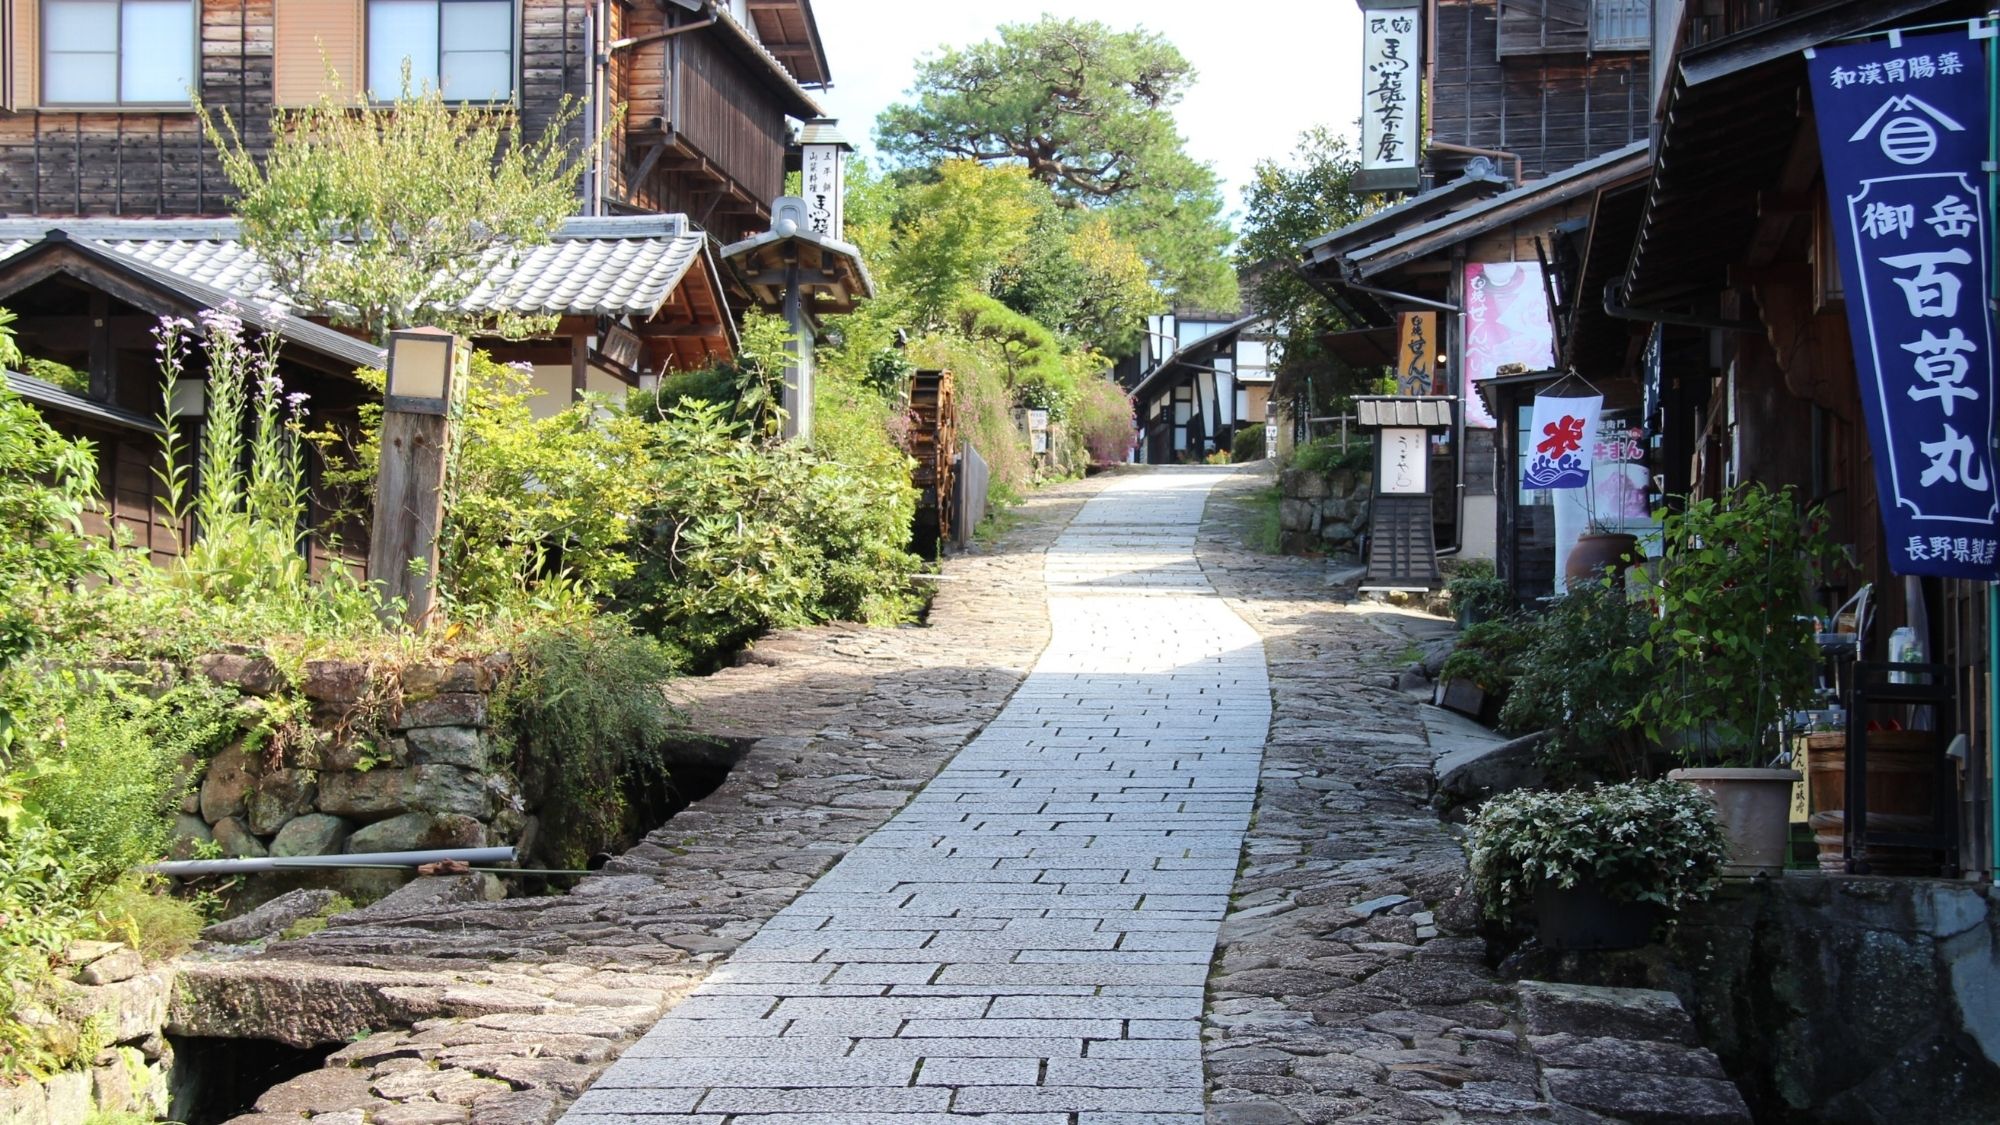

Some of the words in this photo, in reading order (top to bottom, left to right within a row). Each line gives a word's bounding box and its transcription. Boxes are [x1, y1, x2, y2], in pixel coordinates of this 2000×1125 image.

[1829, 51, 1965, 90] 和漢胃腸薬
[1367, 38, 1409, 163] 馬籠茶屋
[1860, 194, 1978, 240] 御岳
[1877, 247, 1989, 492] 百草丸
[1536, 414, 1586, 460] 氷
[1904, 535, 1998, 565] 長野県製薬
